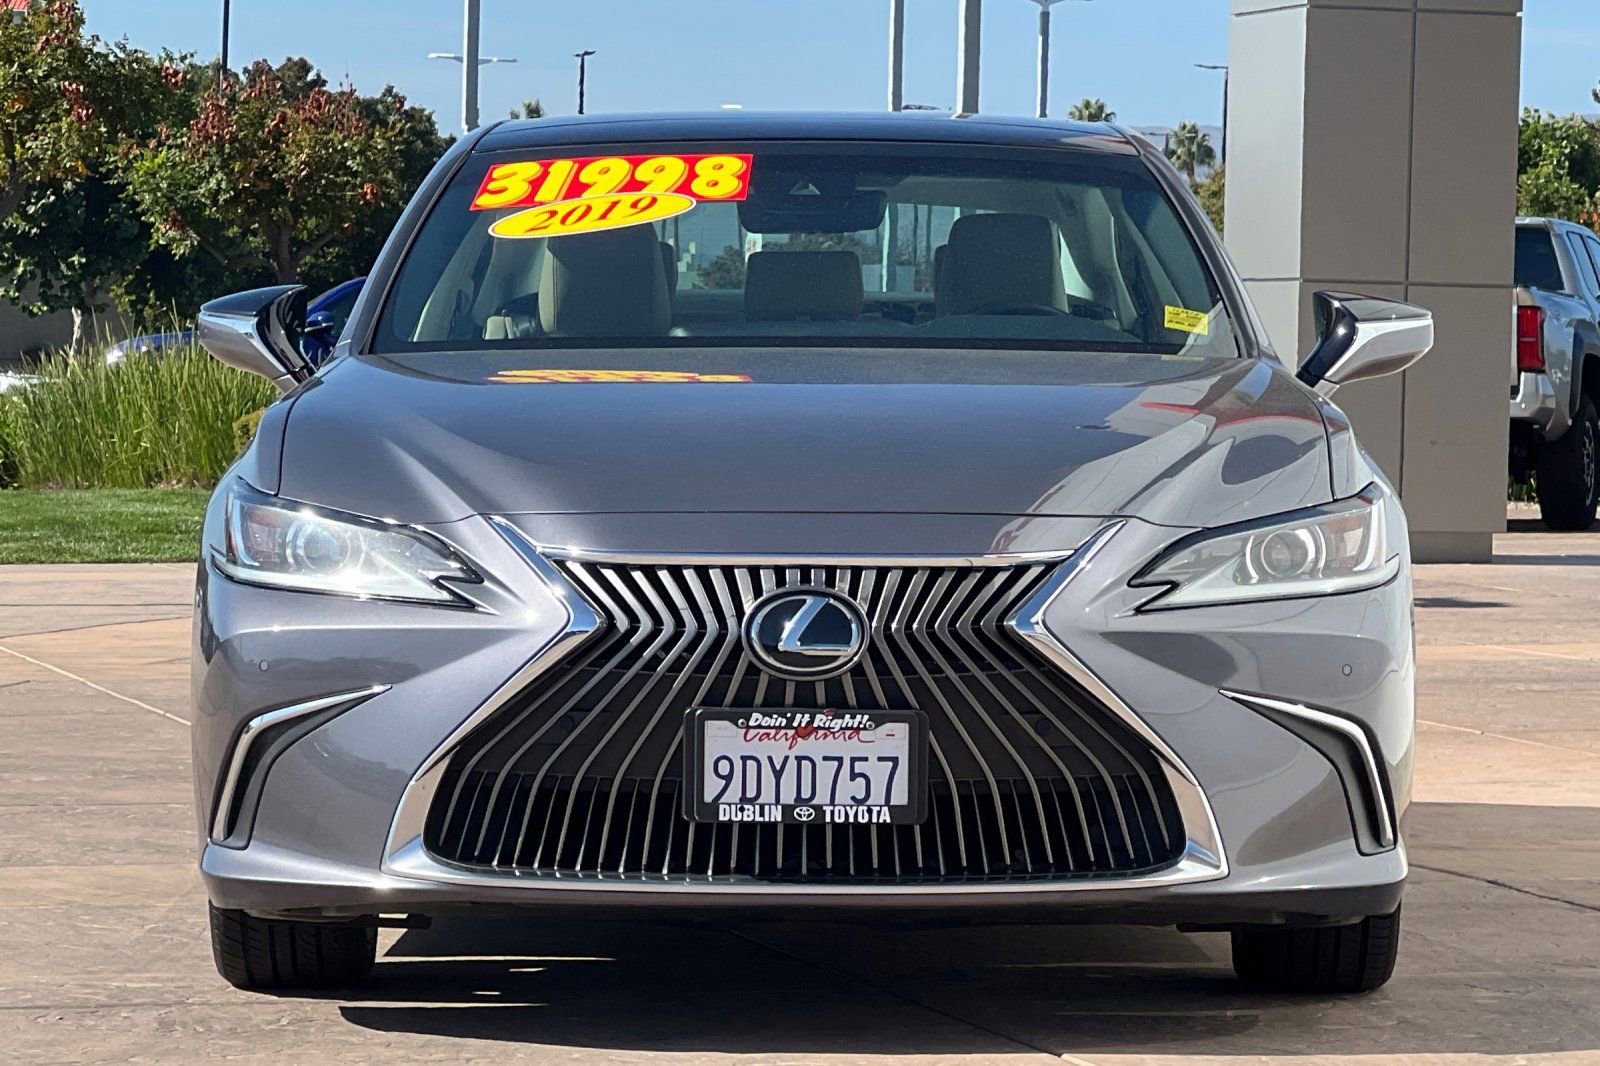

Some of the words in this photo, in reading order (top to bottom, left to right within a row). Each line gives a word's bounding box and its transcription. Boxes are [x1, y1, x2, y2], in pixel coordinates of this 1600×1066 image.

[475, 156, 746, 206] 31998
[525, 196, 658, 233] 2019
[748, 712, 791, 727] Doin'
[792, 713, 810, 727] It
[813, 713, 870, 732] Right!
[711, 755, 900, 805] 9DYD757
[718, 804, 782, 822] DUBLIN
[822, 805, 891, 823] TOYOTA
